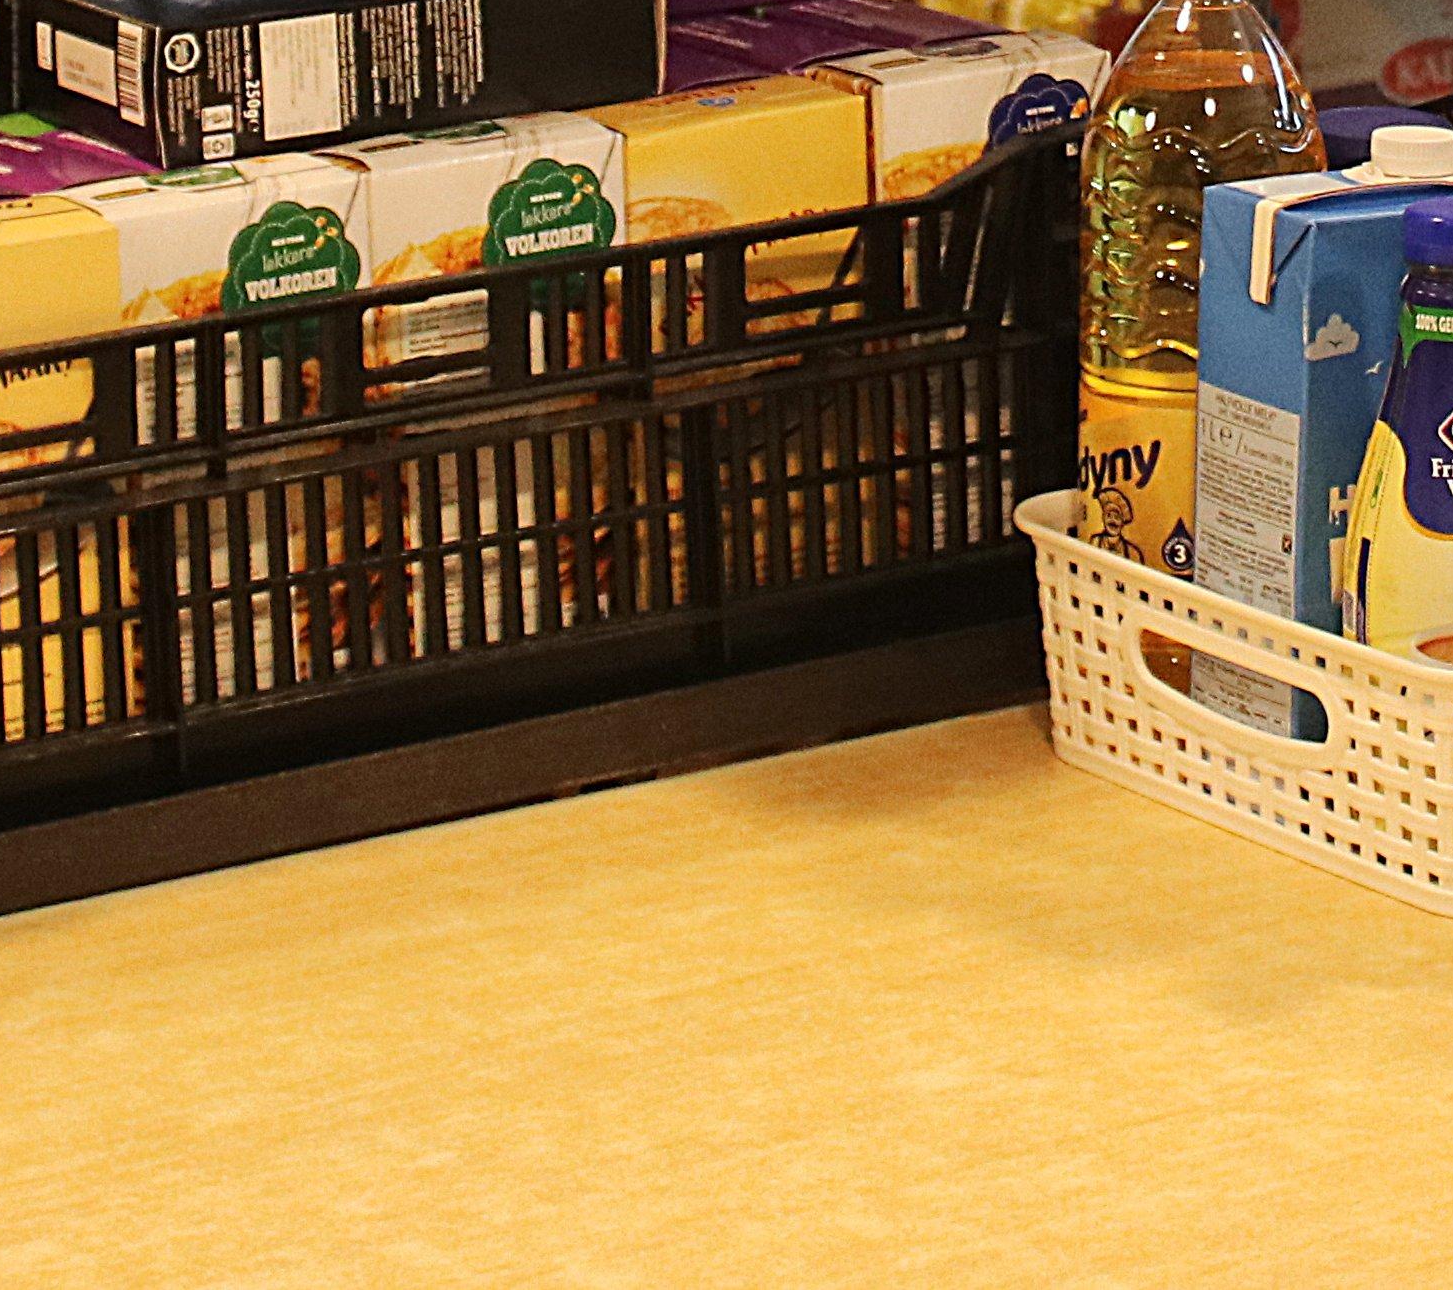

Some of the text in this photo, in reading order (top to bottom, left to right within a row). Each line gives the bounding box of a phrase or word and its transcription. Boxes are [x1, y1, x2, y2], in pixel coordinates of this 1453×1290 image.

[504, 223, 594, 257] VOLKOREN
[244, 266, 338, 303] VOLKOREN
[1079, 439, 1162, 501] dyny
